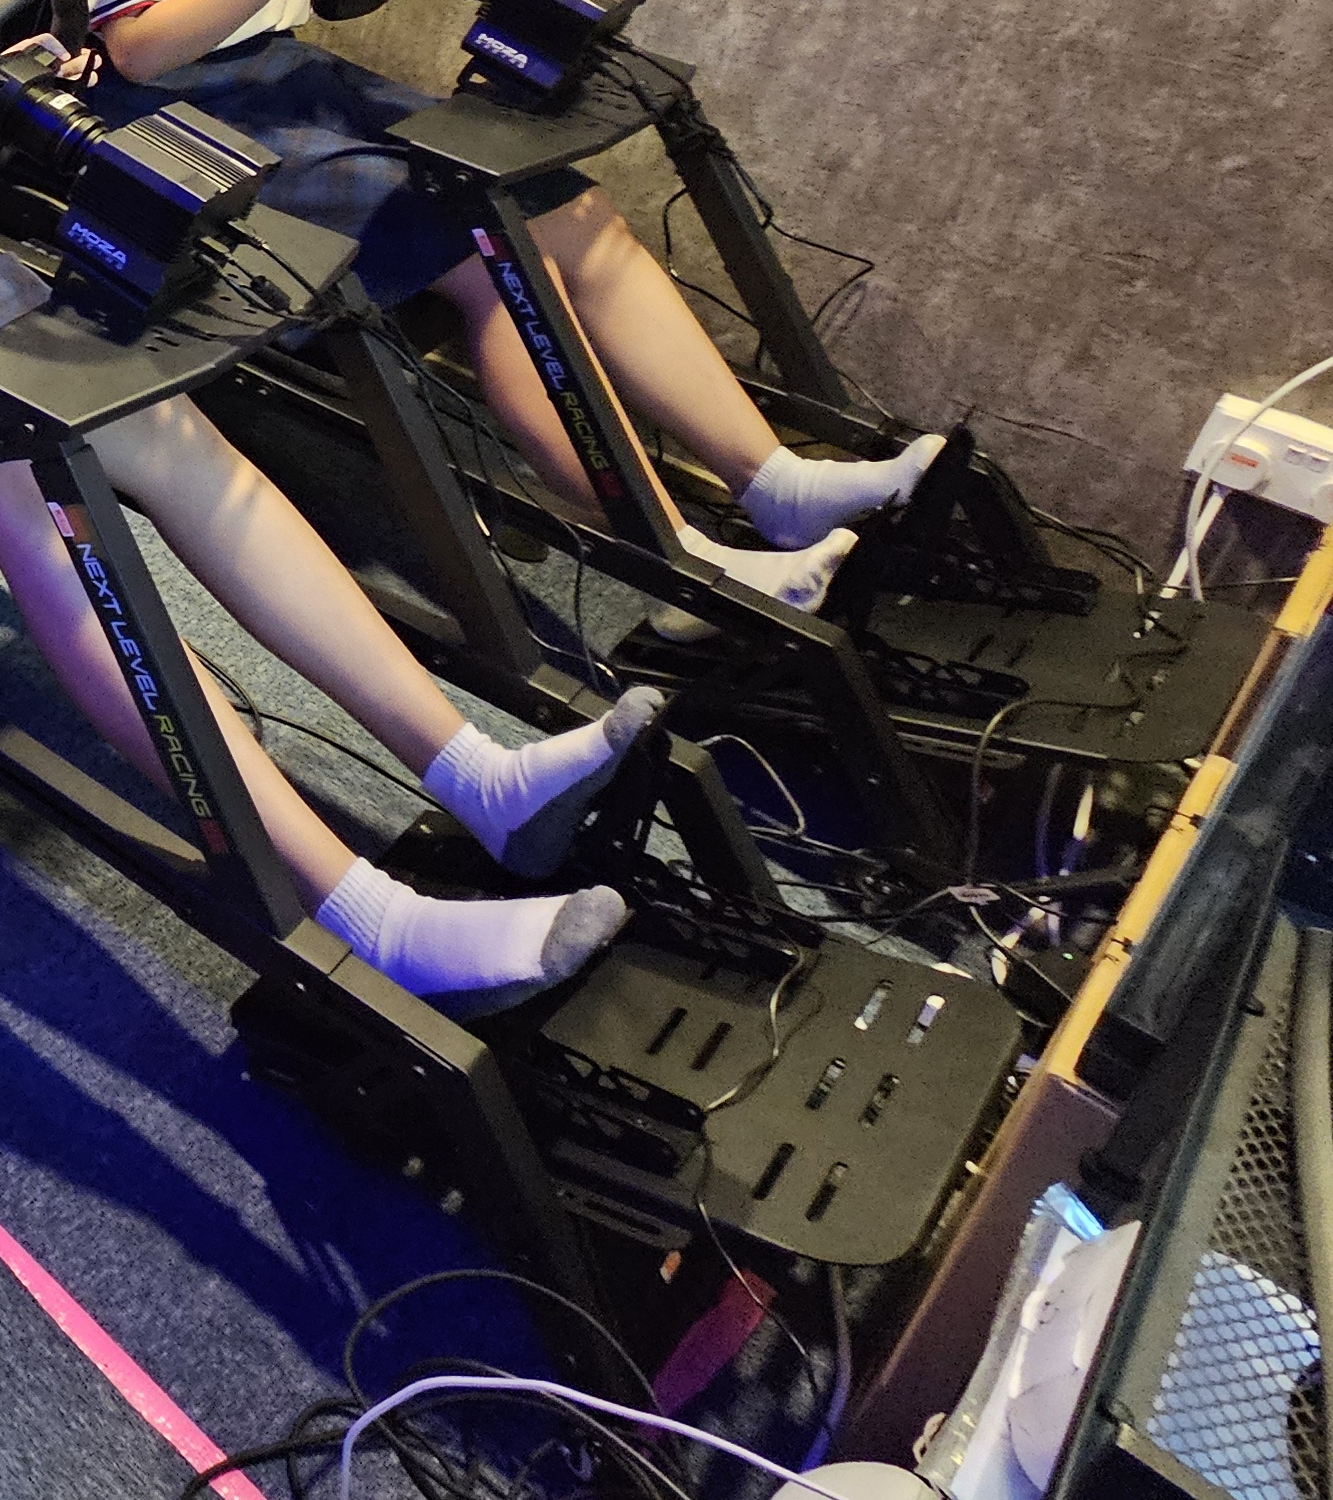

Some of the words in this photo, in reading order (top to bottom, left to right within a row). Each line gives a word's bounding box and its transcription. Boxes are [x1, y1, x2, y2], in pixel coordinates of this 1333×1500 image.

[478, 33, 528, 64] MOZA
[71, 222, 126, 263] MOZA
[497, 261, 537, 316] NEXT
[524, 321, 566, 390] LEVEL
[560, 391, 609, 470] RACING
[77, 542, 122, 615] NEXT
[111, 621, 159, 711] LEVEL
[154, 714, 213, 819] RACING
